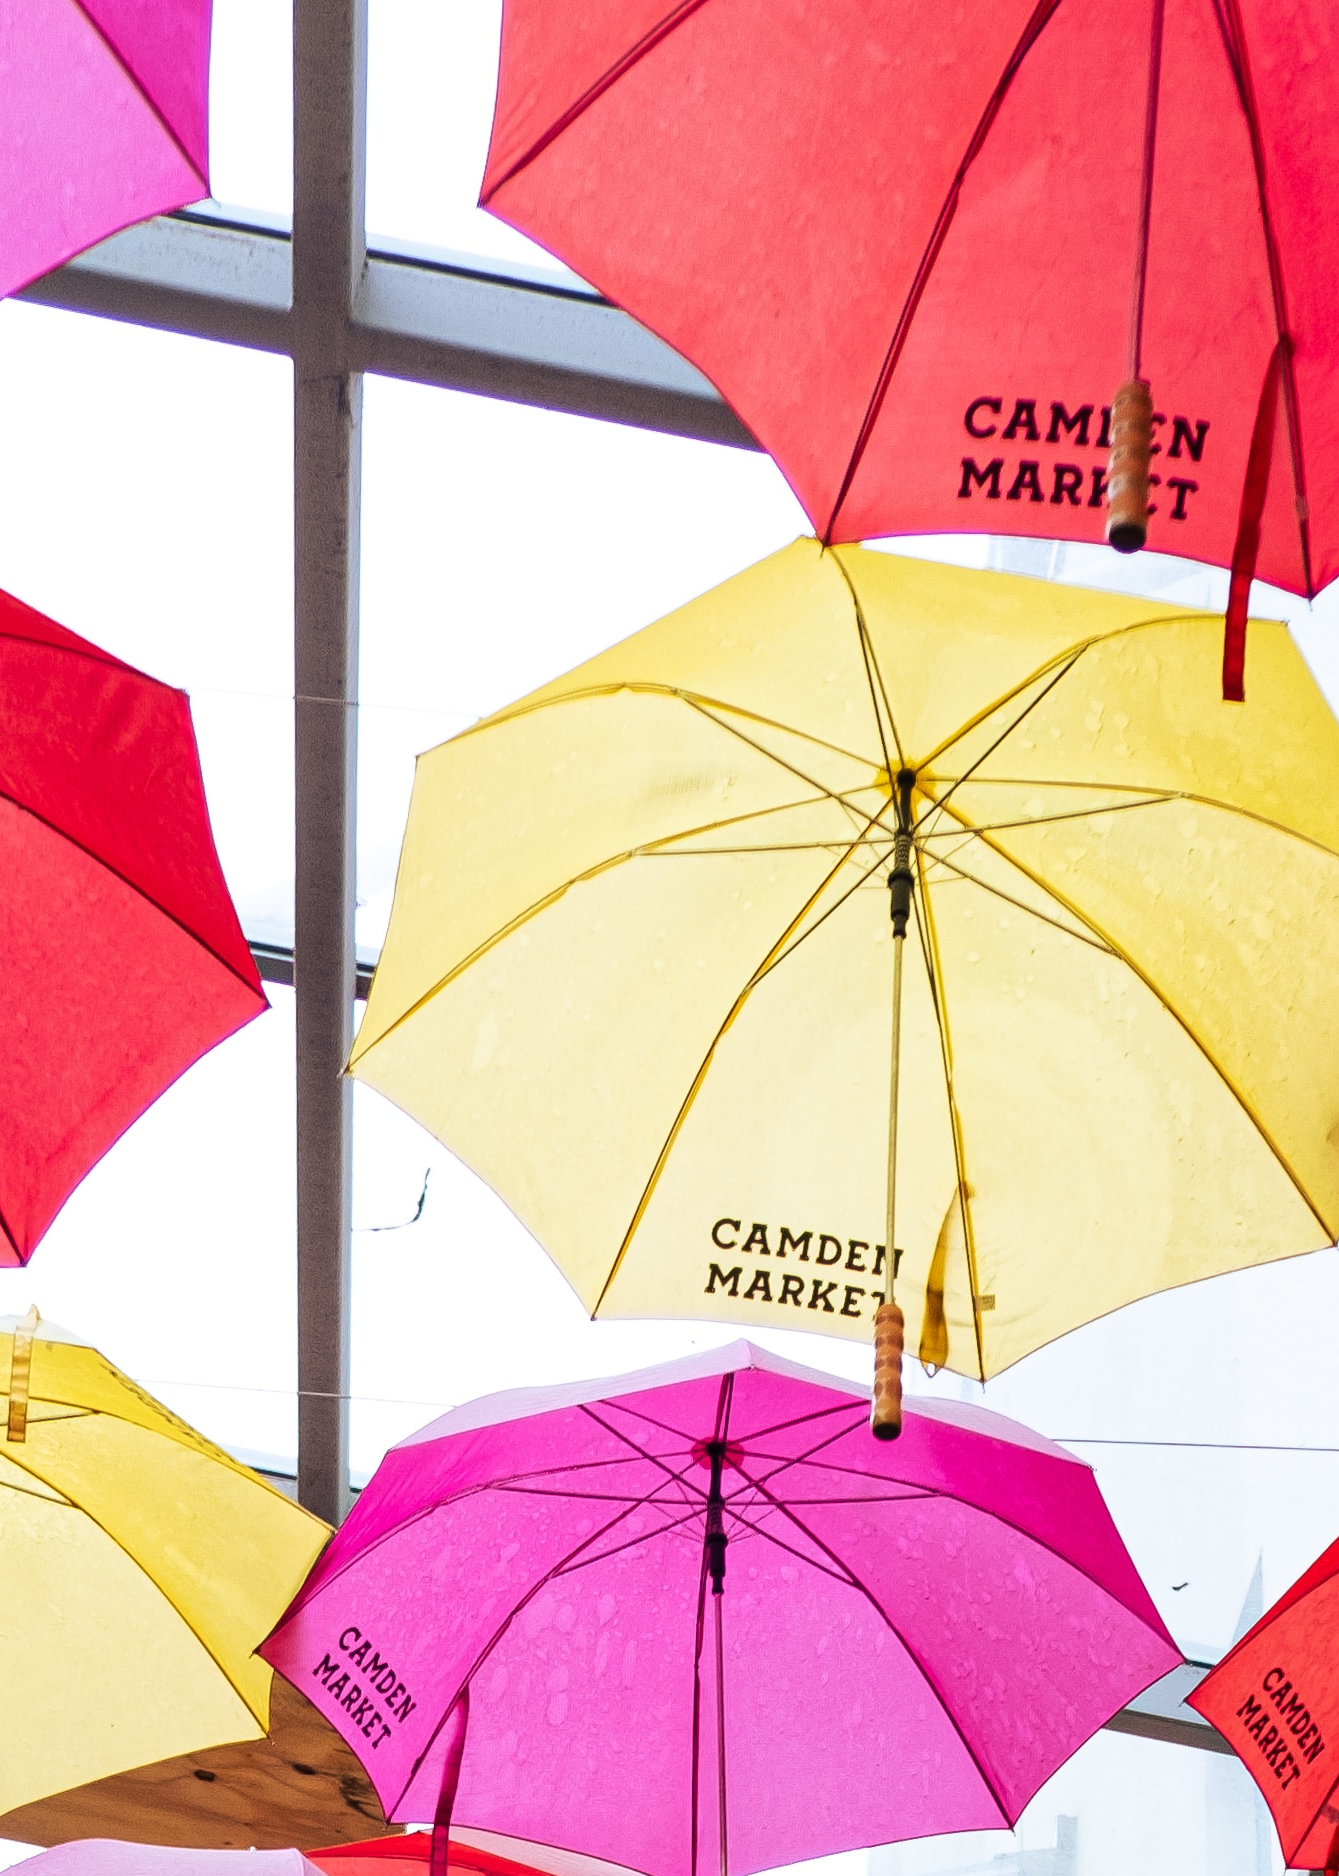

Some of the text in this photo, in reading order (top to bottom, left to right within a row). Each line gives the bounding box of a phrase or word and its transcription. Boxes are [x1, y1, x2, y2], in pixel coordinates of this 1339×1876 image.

[711, 1218, 904, 1279] CAMDEN
[313, 1653, 391, 1749] MARKET
[339, 1627, 417, 1723] CAMDEN
[1263, 1668, 1324, 1764] CAMDEN
[1236, 1694, 1300, 1790] MARKET
